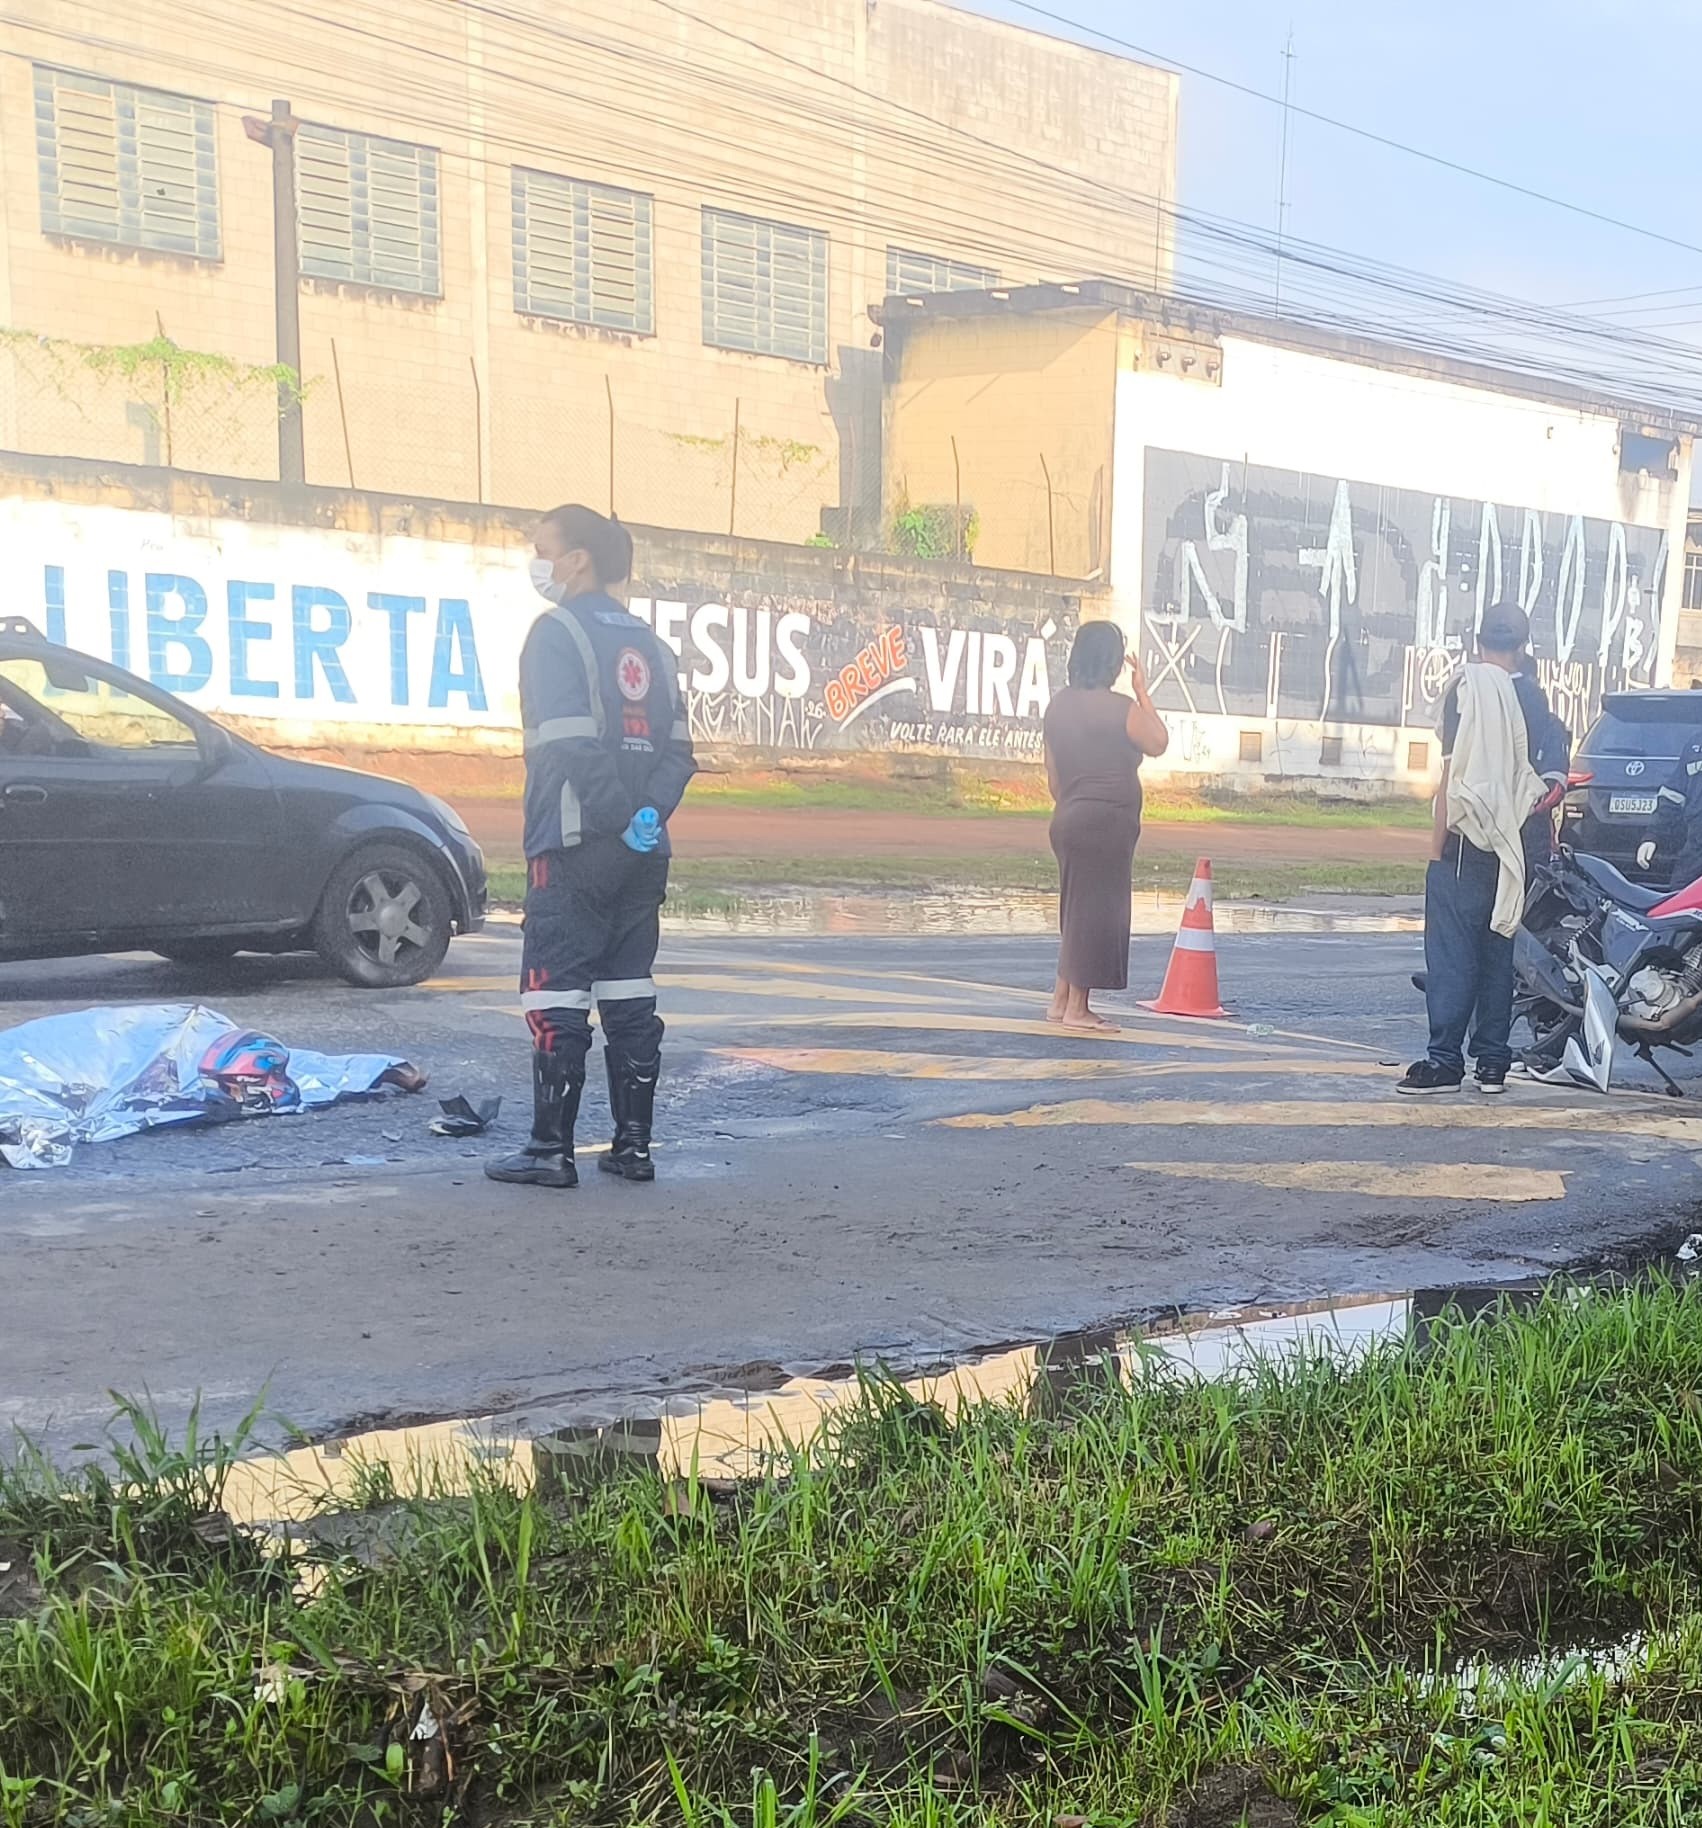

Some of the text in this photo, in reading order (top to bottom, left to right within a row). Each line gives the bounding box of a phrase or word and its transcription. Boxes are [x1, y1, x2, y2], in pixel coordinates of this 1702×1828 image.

[628, 597, 811, 698] ESUS
[823, 624, 907, 722] BREVE
[919, 617, 1058, 720] VIRÁ
[890, 721, 934, 742] VOLTE
[978, 727, 1000, 747] ELE
